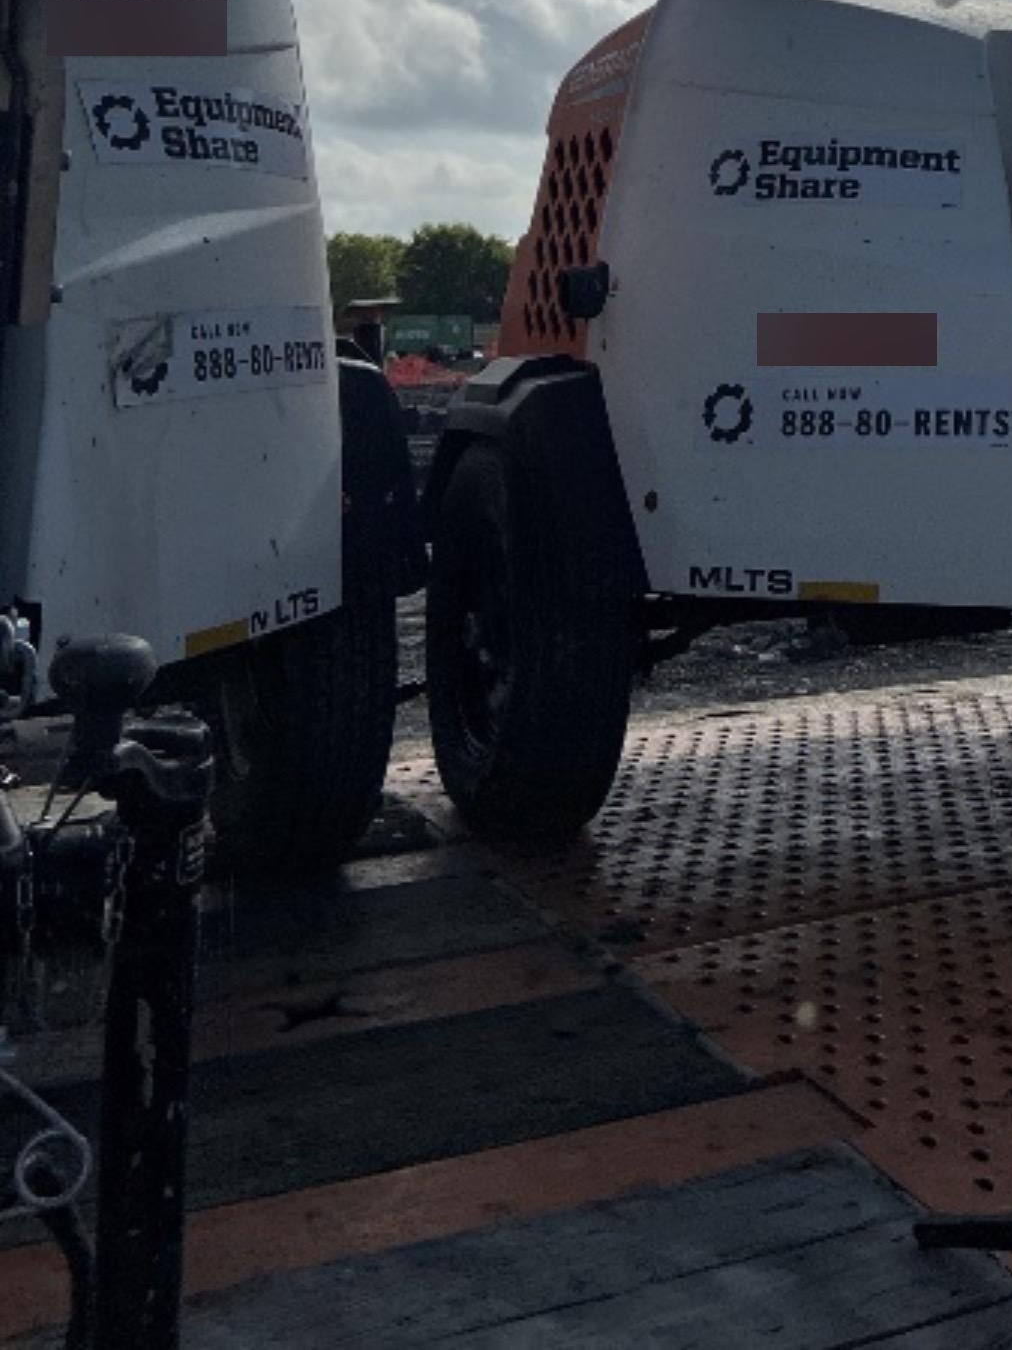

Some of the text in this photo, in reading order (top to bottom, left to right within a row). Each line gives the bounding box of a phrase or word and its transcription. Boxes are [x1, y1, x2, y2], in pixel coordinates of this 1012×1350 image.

[161, 125, 259, 164] Share
[758, 139, 960, 174] Equipment
[754, 173, 860, 200] Share
[782, 388, 820, 402] CALL
[781, 408, 1010, 437] 888-80-RENTS
[689, 565, 793, 594] MLTS
